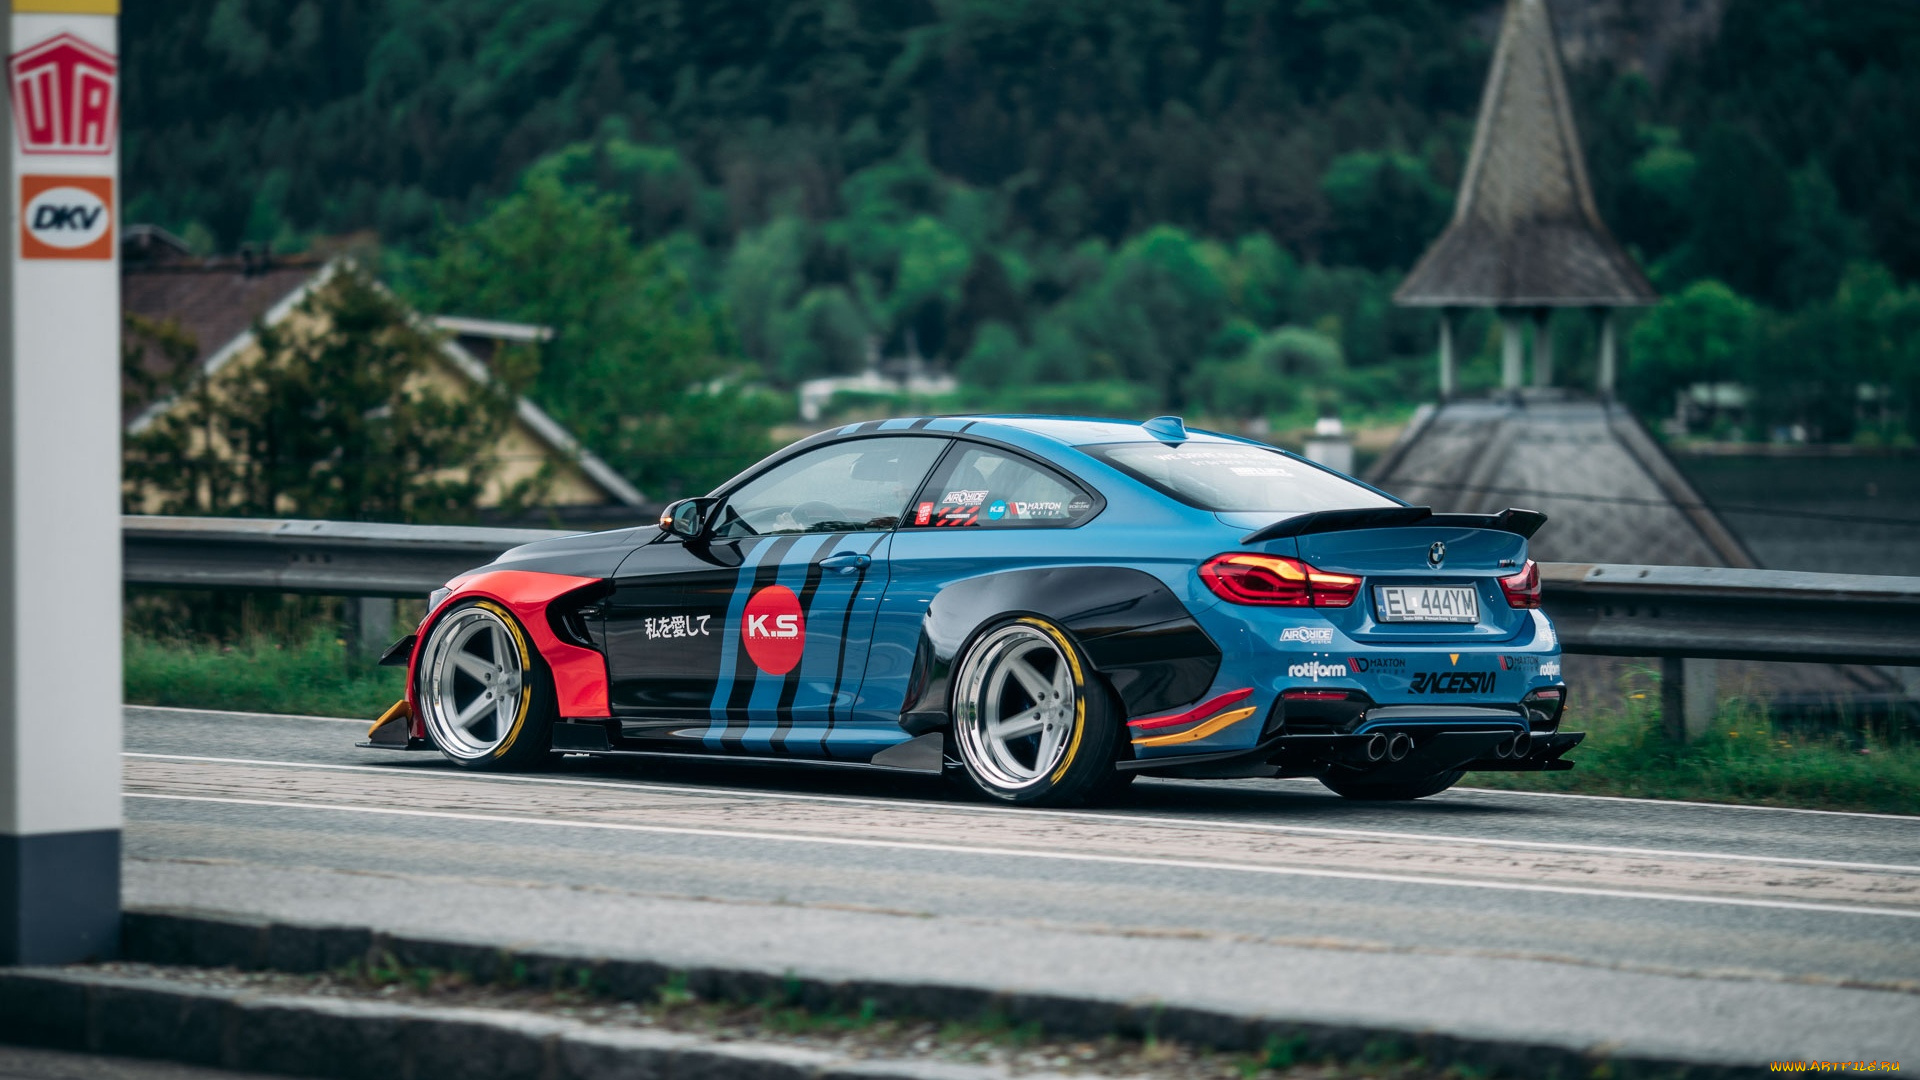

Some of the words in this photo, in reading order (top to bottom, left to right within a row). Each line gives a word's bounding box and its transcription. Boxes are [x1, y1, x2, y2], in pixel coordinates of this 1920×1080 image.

[16, 43, 116, 146] UTA
[33, 205, 102, 230] DKV
[1027, 502, 1062, 510] MAXTON
[1386, 589, 1415, 615] EL
[1421, 589, 1475, 616] 444YM
[644, 614, 711, 640] 私を愛して
[748, 614, 798, 637] K.S
[1288, 661, 1346, 682] rotiform
[1370, 659, 1405, 667] MAXTON
[1513, 656, 1538, 665] MAXTON
